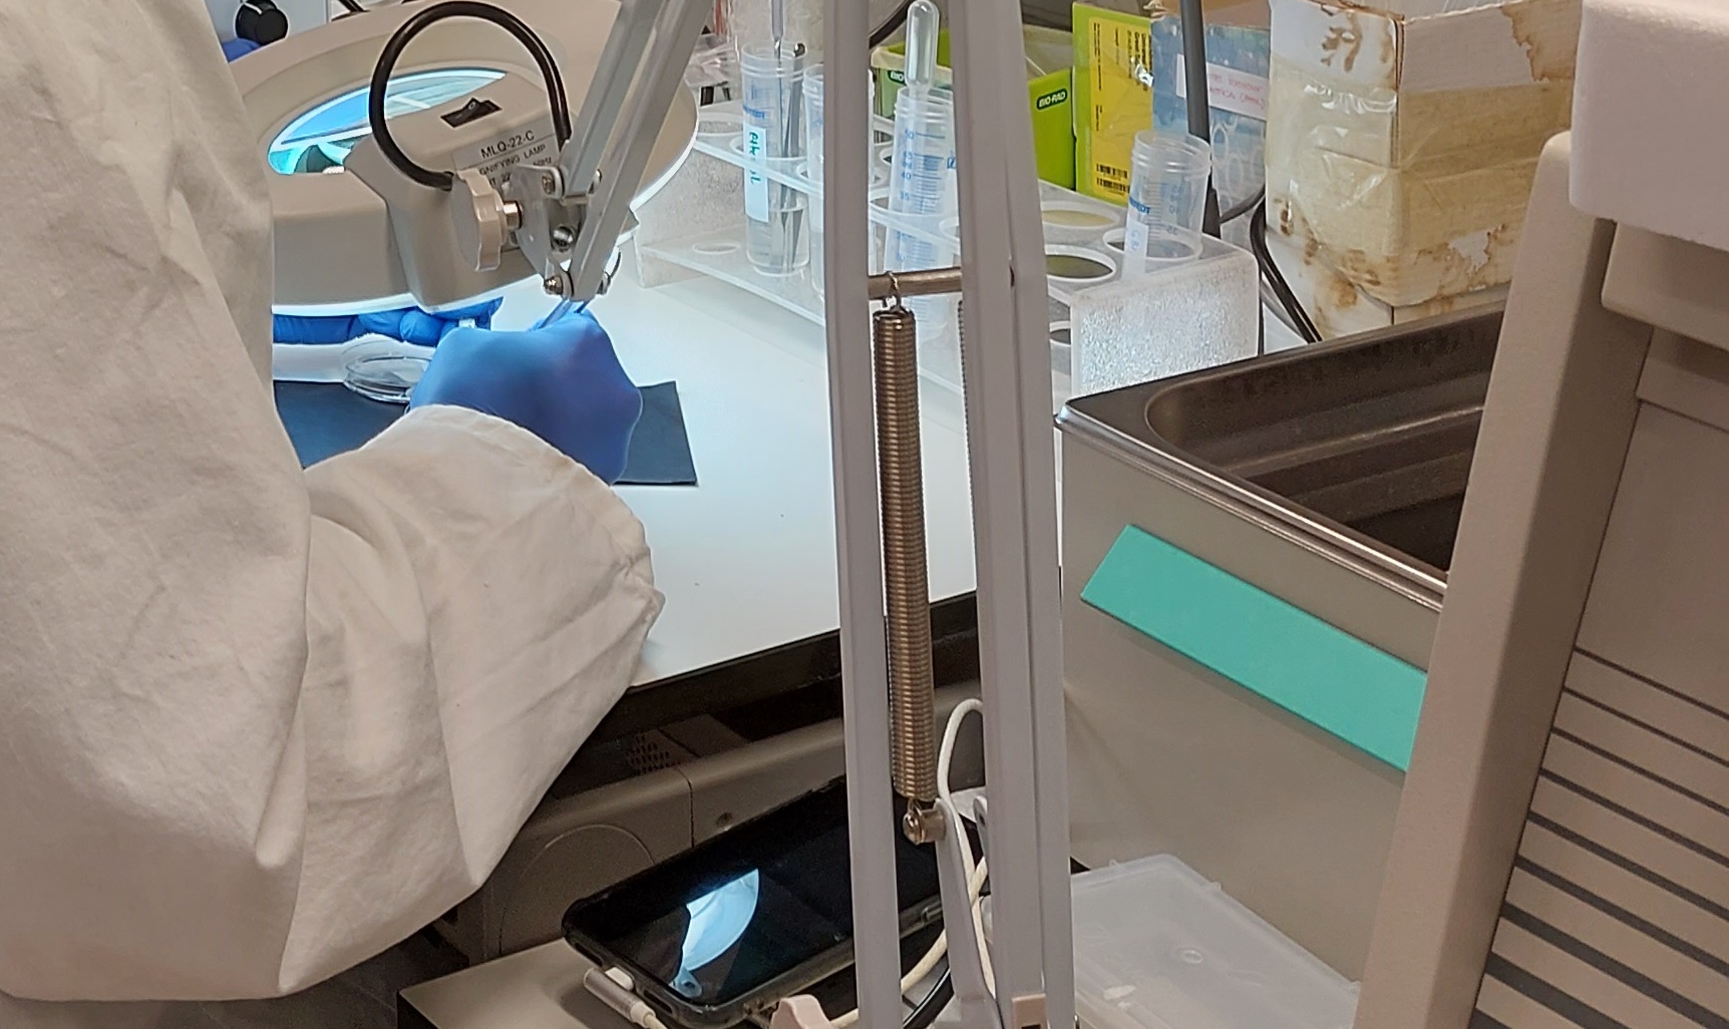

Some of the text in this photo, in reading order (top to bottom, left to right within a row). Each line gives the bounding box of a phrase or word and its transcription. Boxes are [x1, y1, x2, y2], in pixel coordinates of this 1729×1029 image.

[1039, 91, 1066, 108] BIO-RAD
[480, 130, 535, 159] MLQ-22-C
[478, 144, 546, 176] GNIFYING LAMP
